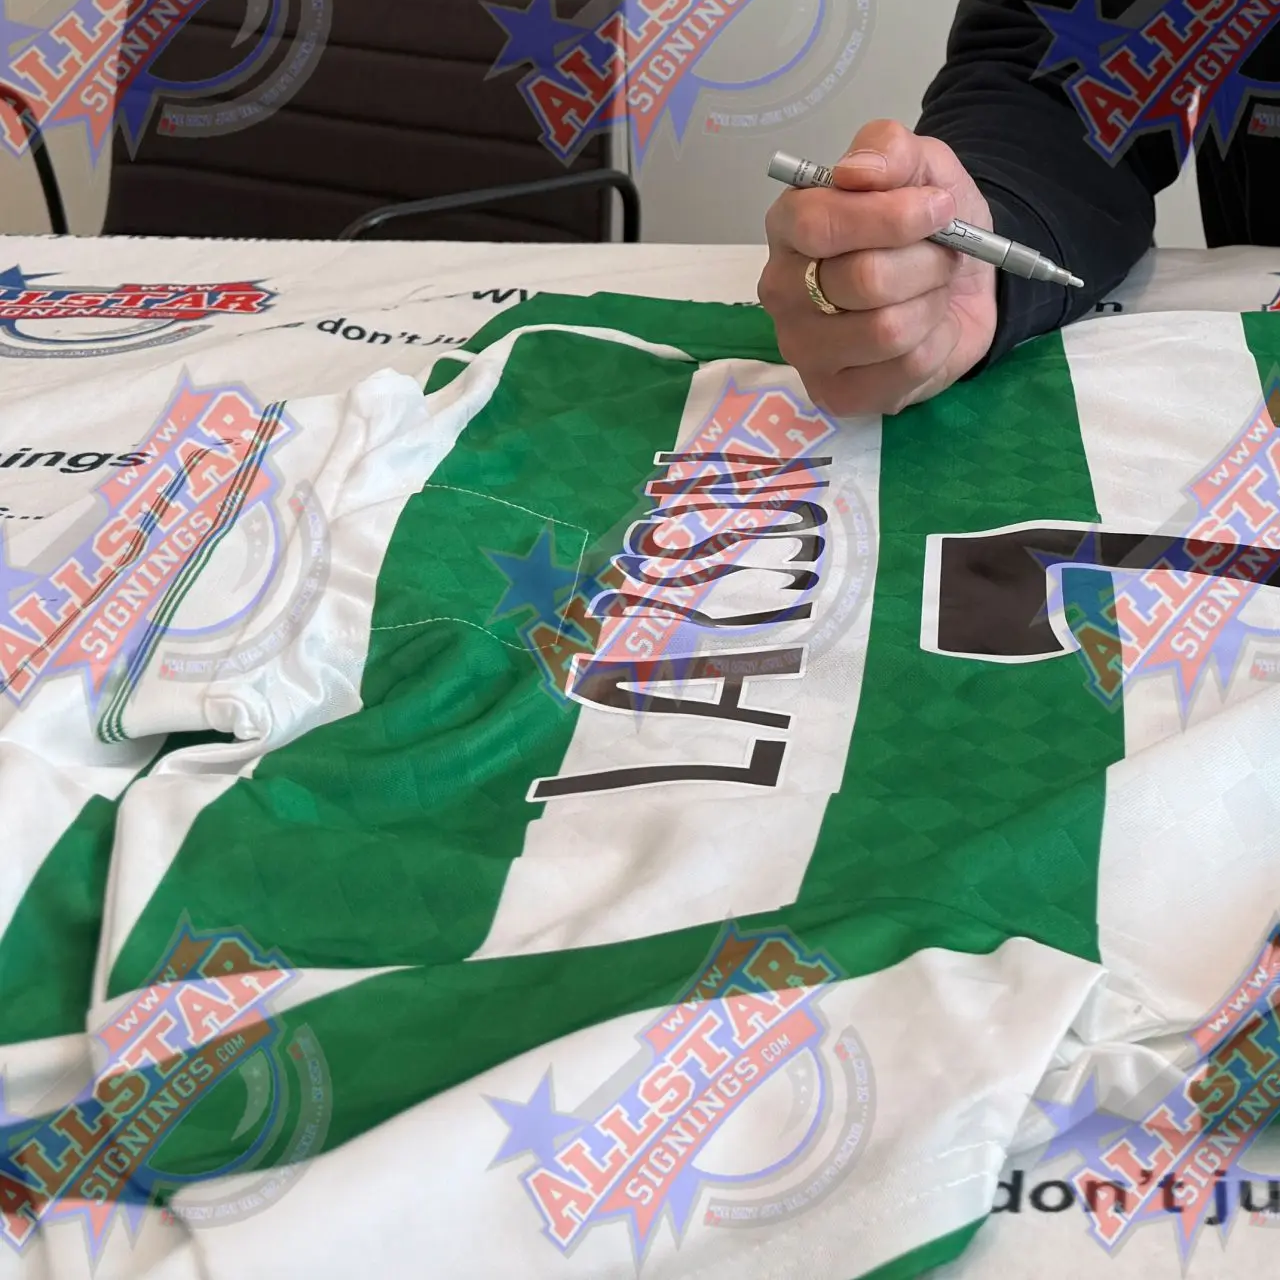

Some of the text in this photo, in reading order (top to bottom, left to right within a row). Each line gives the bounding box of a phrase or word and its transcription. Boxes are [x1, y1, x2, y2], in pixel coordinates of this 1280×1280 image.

[0, 290, 269, 314] LSTAR
[317, 317, 421, 345] don't
[527, 451, 833, 802] LARSSON
[991, 1169, 1185, 1213] don't
